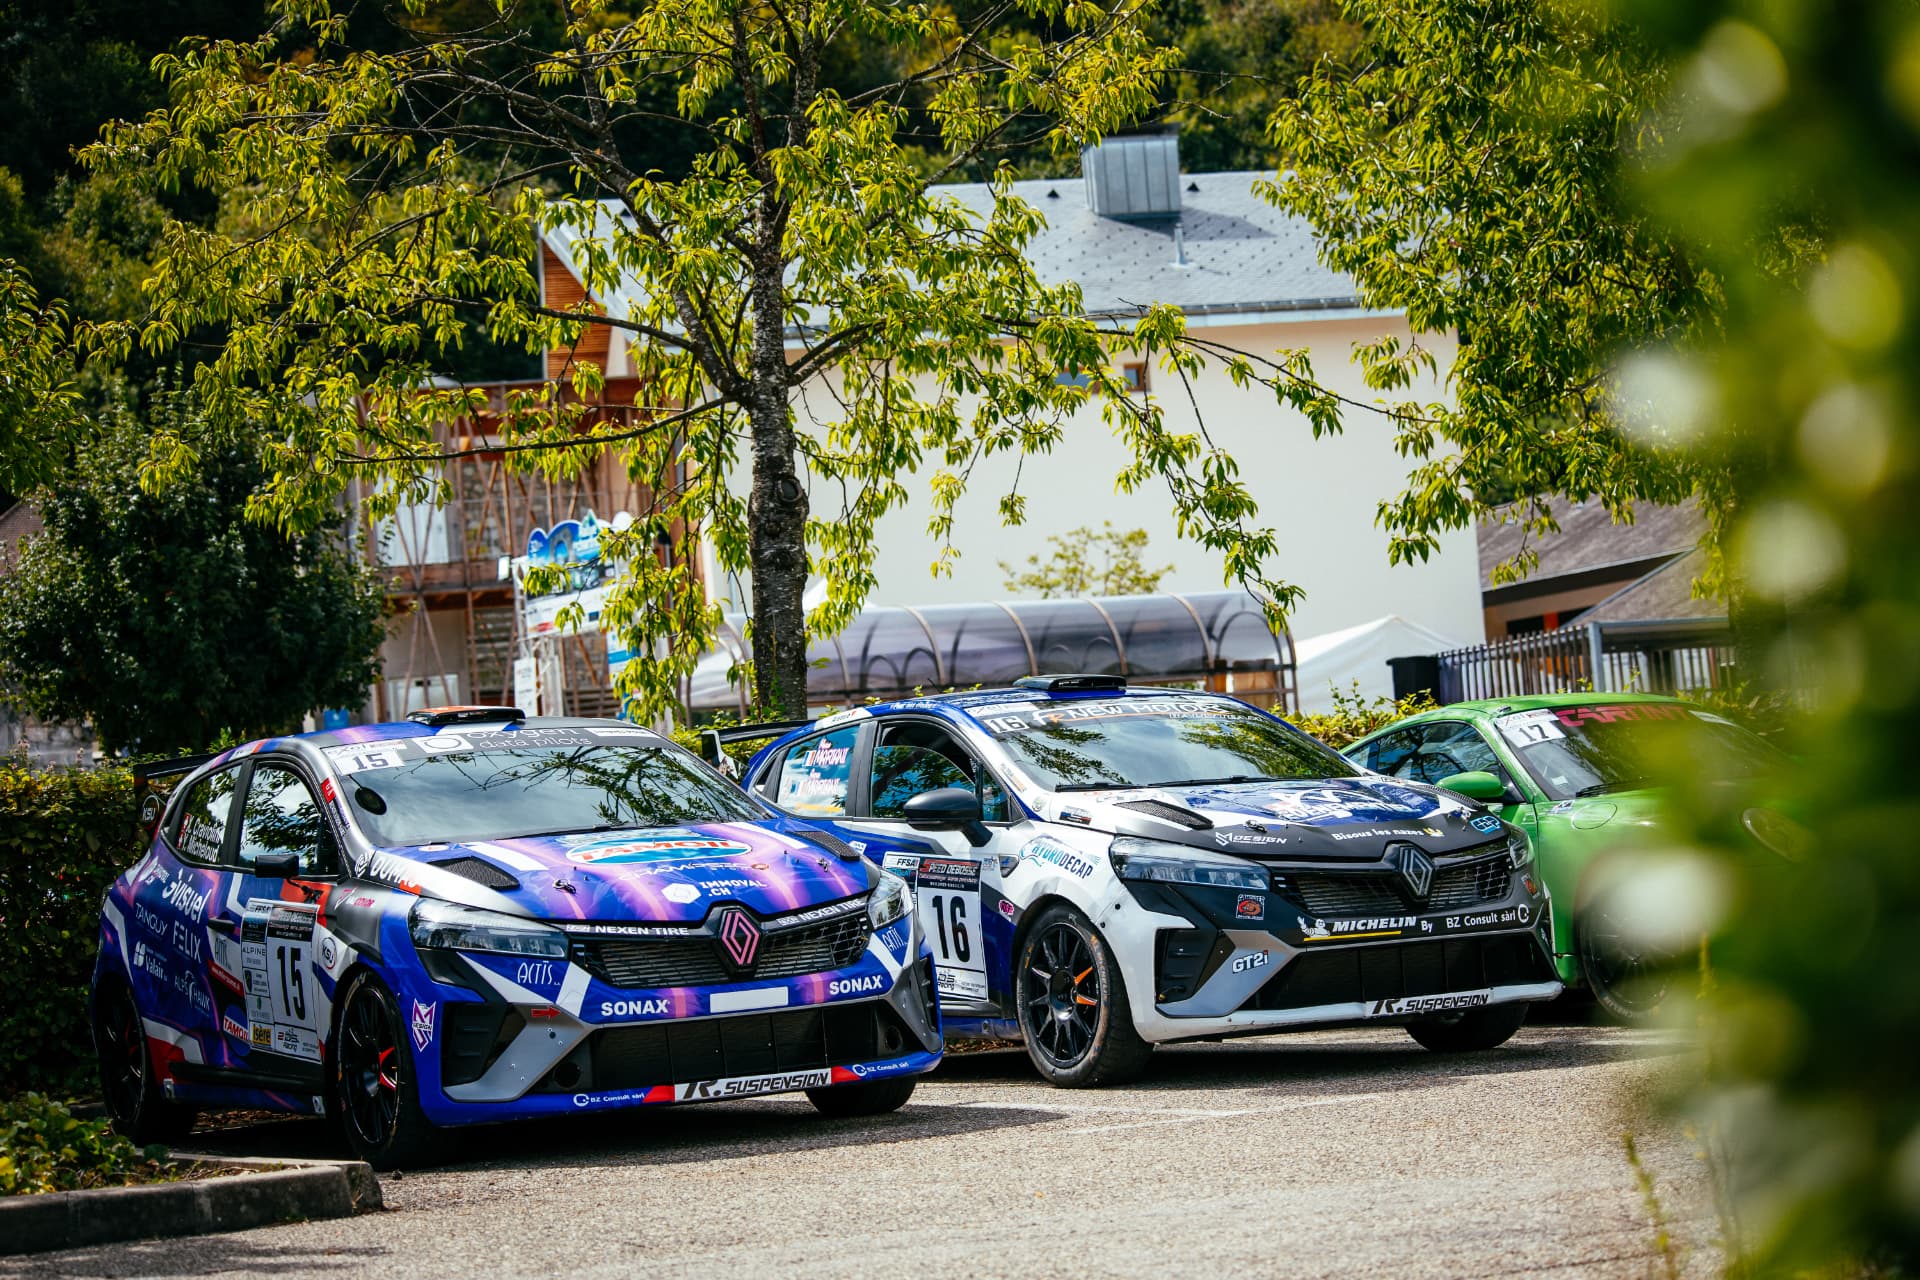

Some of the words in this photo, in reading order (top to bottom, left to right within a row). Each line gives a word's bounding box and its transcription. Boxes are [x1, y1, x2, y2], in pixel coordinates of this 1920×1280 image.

[1069, 704, 1122, 719] NEW
[990, 717, 1025, 732] 16
[1518, 723, 1550, 742] 17
[466, 728, 580, 741] oxygen
[479, 736, 530, 748] data
[533, 735, 593, 748] pilots
[352, 753, 389, 770] 15
[1331, 831, 1373, 841] Bisous
[1373, 828, 1391, 837] les
[571, 841, 747, 861] TAMOIL
[1031, 842, 1093, 879] HYDRODECAP
[699, 878, 767, 889] IMMOVAL
[798, 905, 840, 922] NEXEN
[595, 925, 650, 936] NEXEN
[651, 927, 690, 936] TIRE
[932, 895, 970, 963] 16
[1332, 916, 1418, 932] MICHELIN
[1421, 920, 1433, 933] By
[1446, 916, 1461, 929] BZ
[1464, 913, 1499, 927] Consult
[242, 945, 266, 957] ALPINE
[1232, 950, 1269, 975] GT2i
[276, 945, 306, 1020] 15
[829, 975, 883, 995] SONAX
[601, 999, 669, 1017] SONAX
